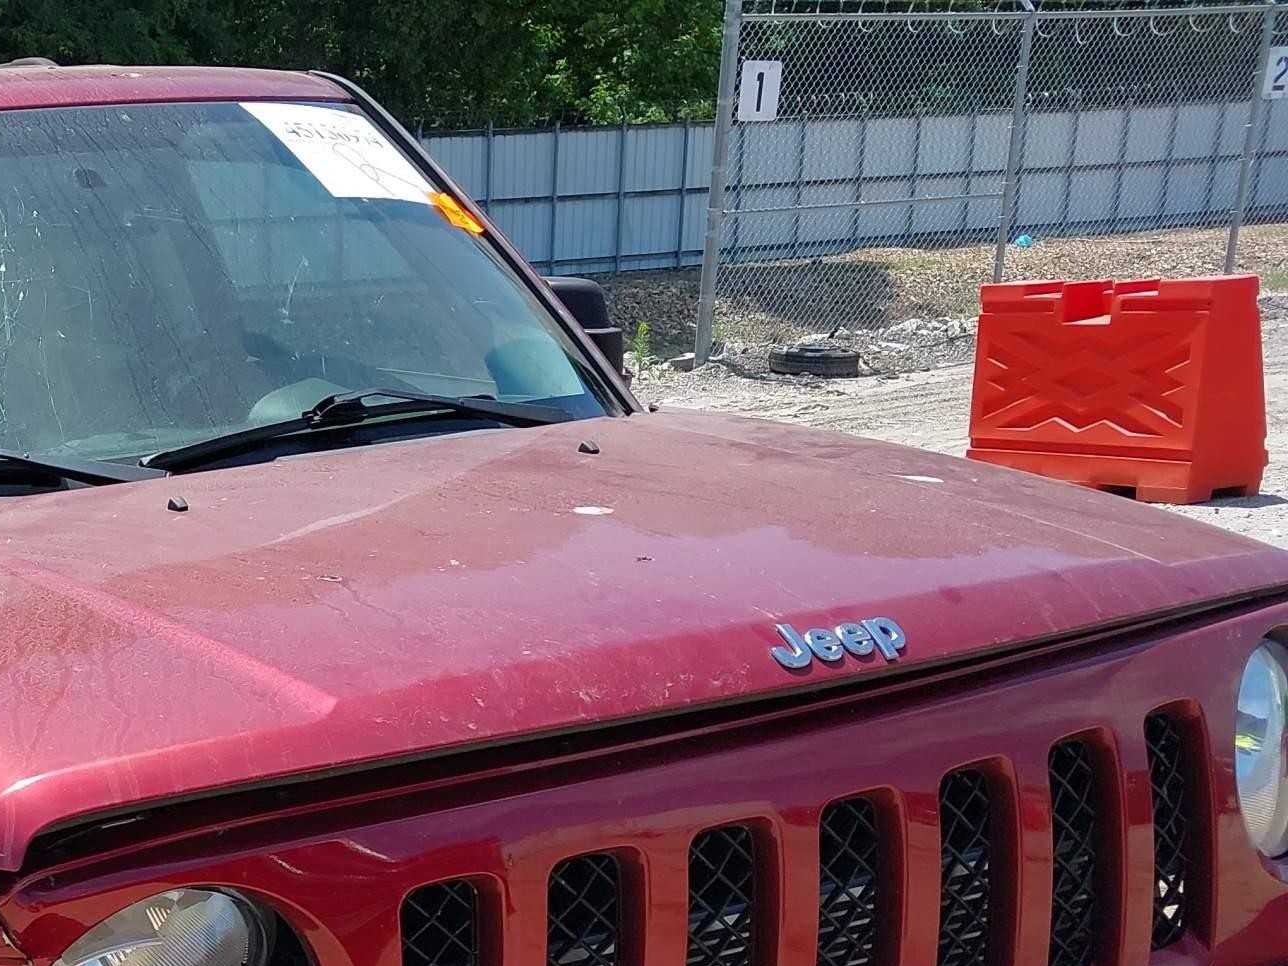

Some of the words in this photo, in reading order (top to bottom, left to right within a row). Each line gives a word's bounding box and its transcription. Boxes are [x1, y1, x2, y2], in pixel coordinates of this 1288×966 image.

[755, 71, 765, 113] 1
[1271, 55, 1288, 92] 2
[771, 616, 907, 669] Jeep
